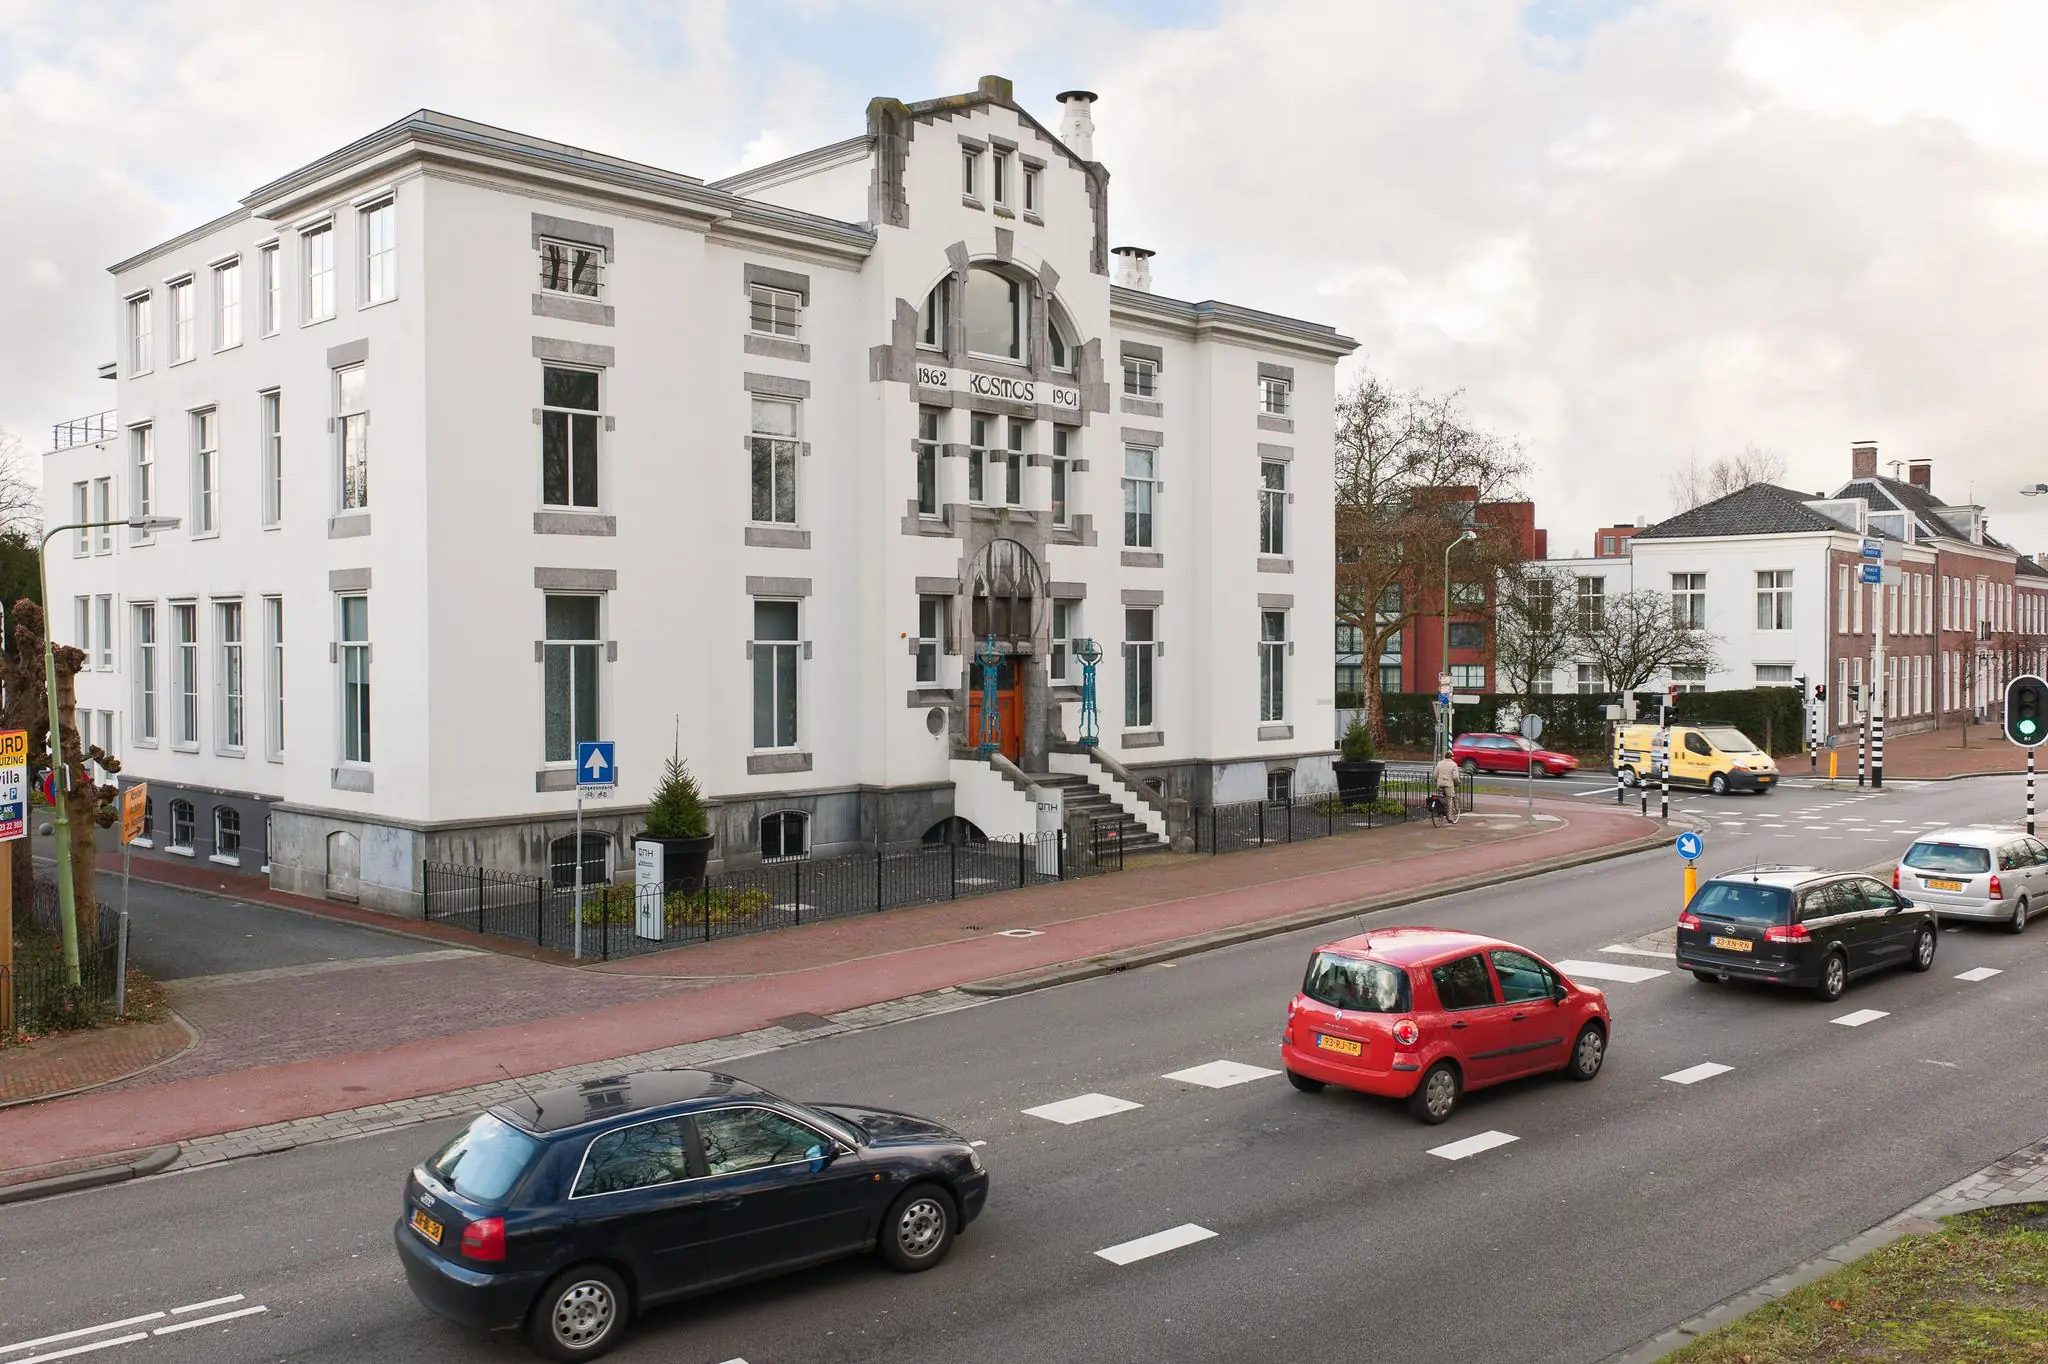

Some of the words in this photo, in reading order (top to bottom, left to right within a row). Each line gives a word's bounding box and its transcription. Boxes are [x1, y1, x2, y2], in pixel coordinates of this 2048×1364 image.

[918, 367, 948, 387] 1862
[969, 373, 1035, 402] KOSMOS
[1052, 388, 1078, 407] 1901
[0, 769, 20, 785] illa
[1324, 1037, 1358, 1052] 93-RJ-TR
